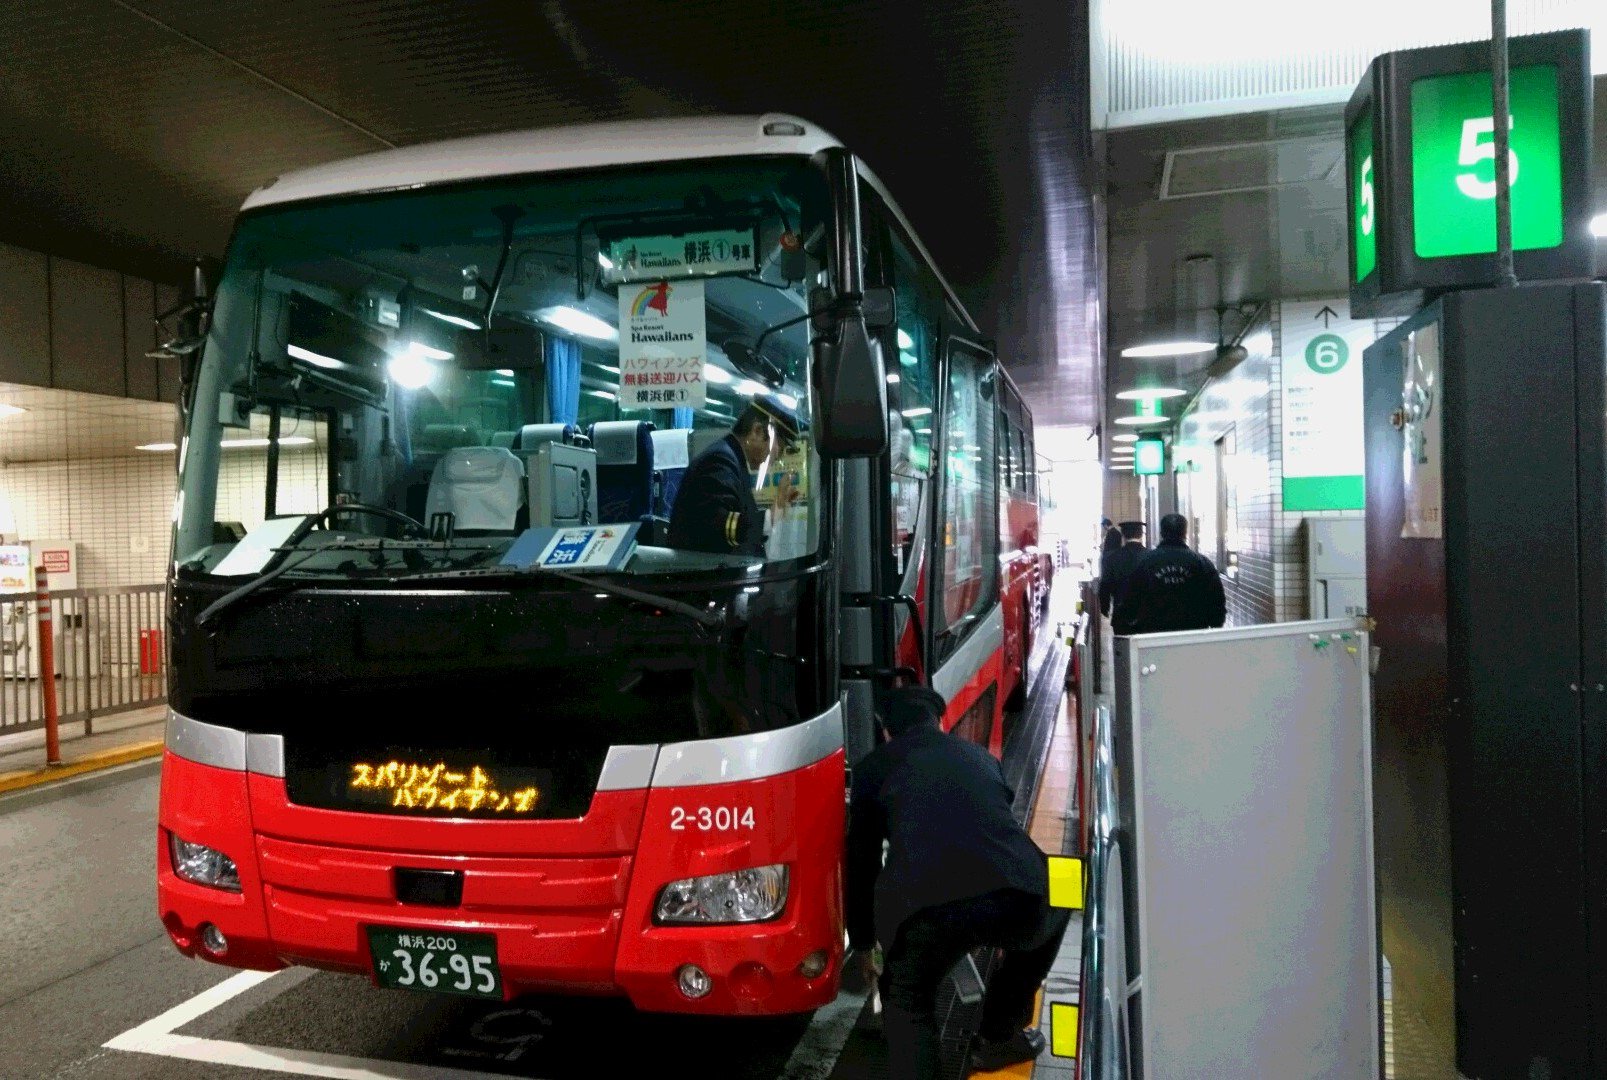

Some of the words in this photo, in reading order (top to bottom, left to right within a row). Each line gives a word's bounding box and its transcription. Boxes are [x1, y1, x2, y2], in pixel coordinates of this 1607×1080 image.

[1455, 114, 1519, 200] 5
[1361, 154, 1374, 236] 5
[631, 331, 694, 343] Hawaiians
[1315, 342, 1339, 367] 6
[624, 372, 701, 386] 無料送迎バス
[636, 389, 689, 402] 横浜便①
[352, 761, 487, 788] スパリゾート
[393, 786, 537, 812] ハワイアンズ
[670, 806, 756, 831] 2-3014
[392, 949, 495, 993] 36-95
